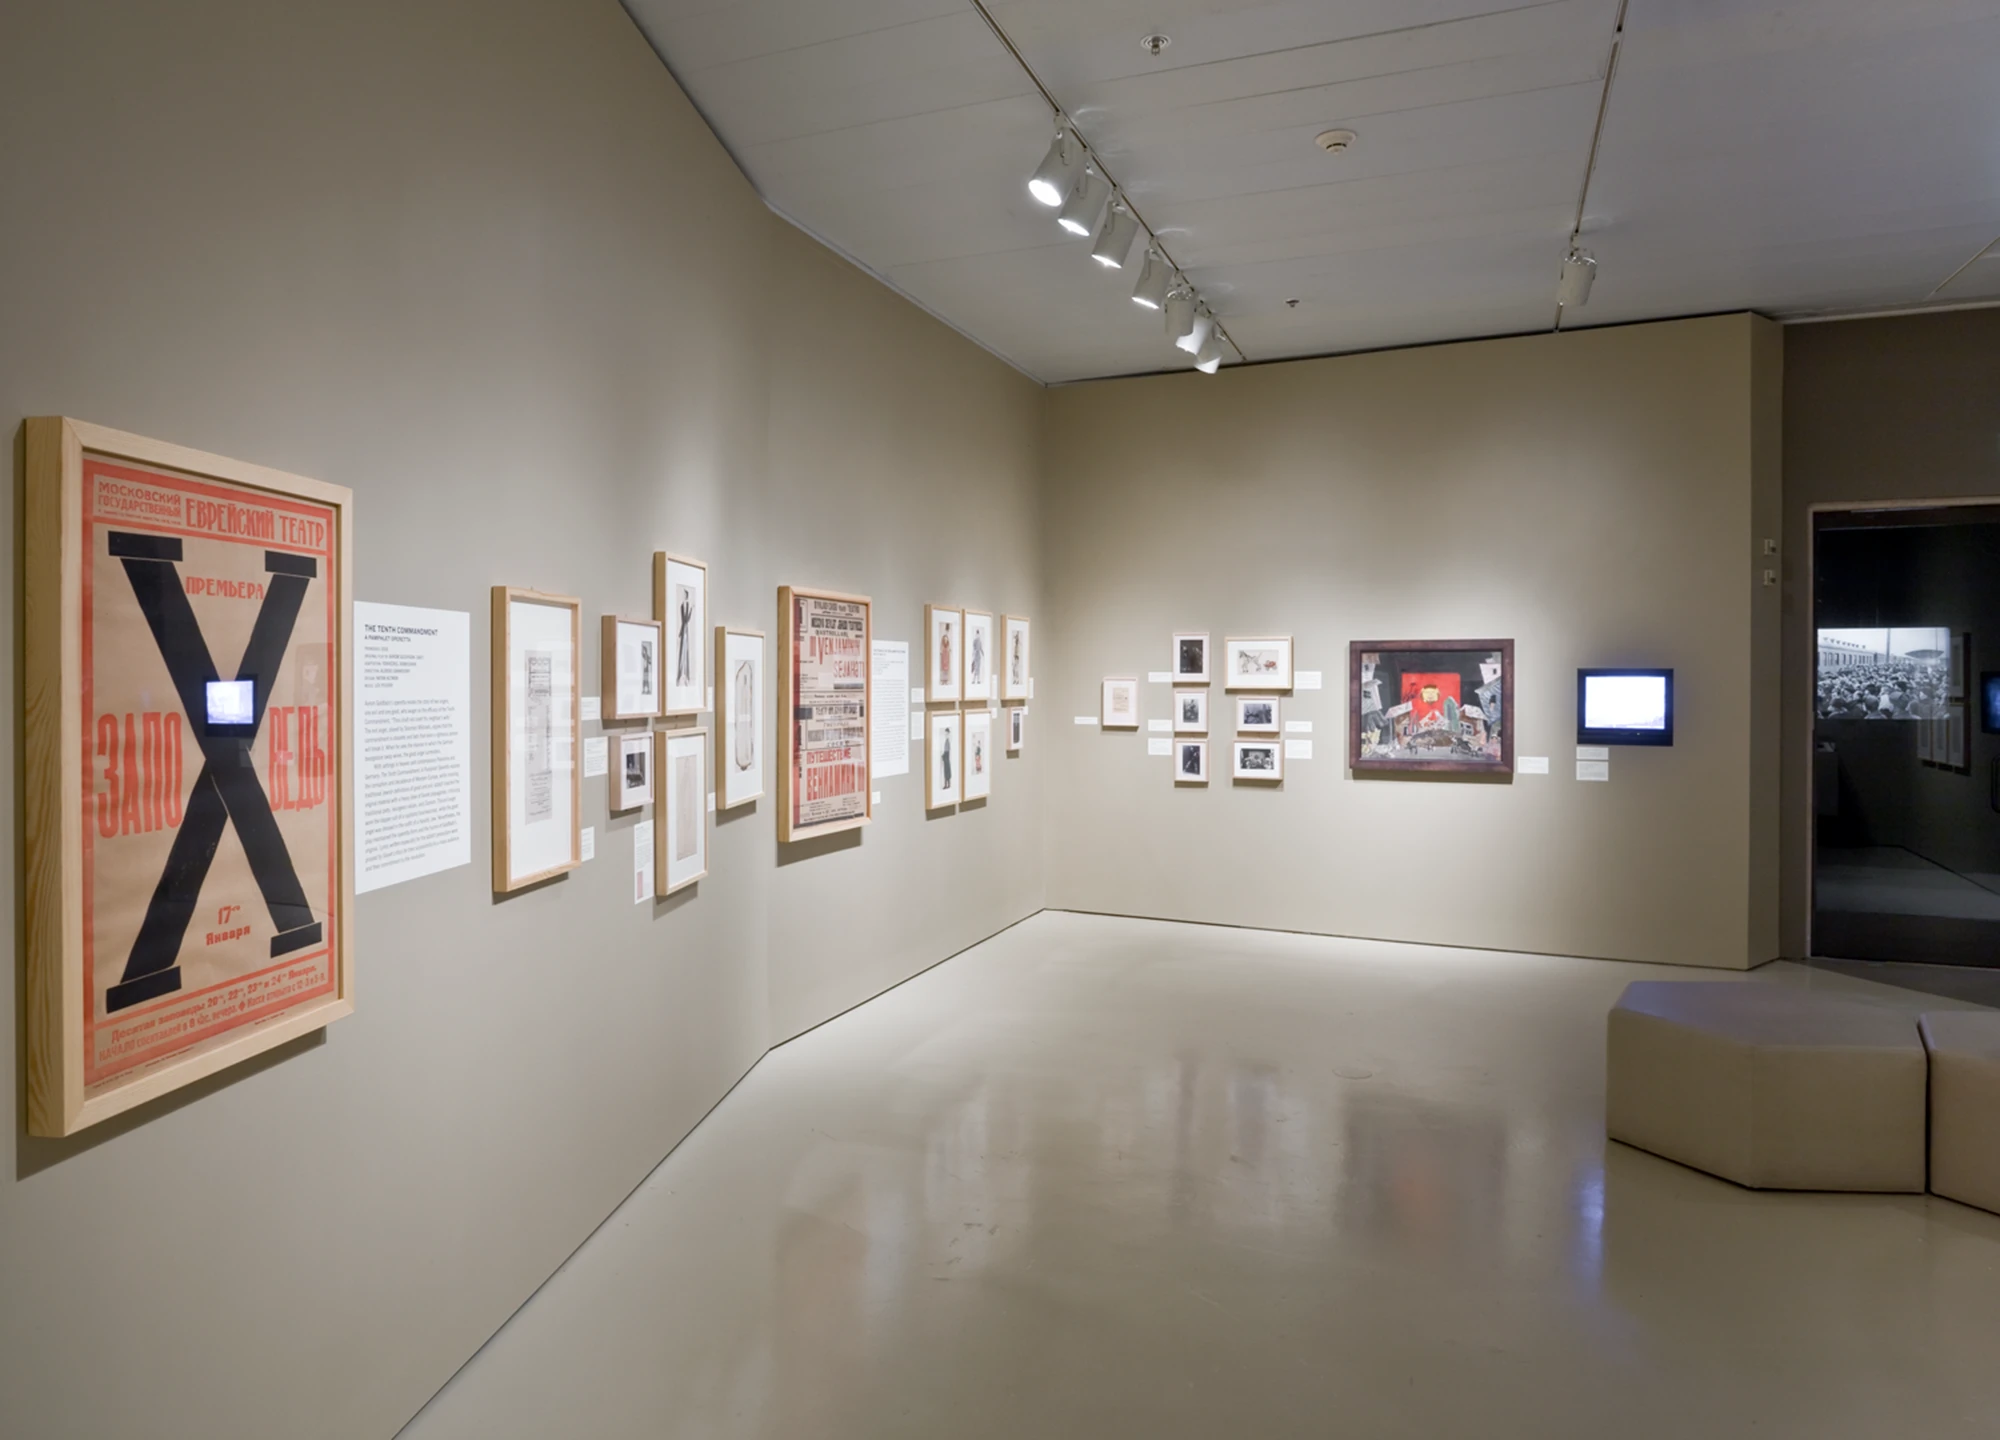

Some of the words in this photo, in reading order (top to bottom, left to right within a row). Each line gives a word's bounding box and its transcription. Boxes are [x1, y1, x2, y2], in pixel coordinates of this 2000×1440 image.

[99, 481, 181, 505] МОСКОВСКИЙ
[98, 495, 181, 518] ГОСУДАРСТВЕННЫЙ
[186, 499, 275, 541] ЕВРЕЙСКИЙ
[279, 515, 324, 547] ТЕАТР
[186, 576, 265, 600] ПРЕМЬЕРА
[365, 624, 376, 632] THE
[377, 625, 396, 633] TENTH
[397, 627, 438, 636] COMMANDMENT
[97, 712, 183, 838] ЗАПО
[269, 706, 326, 812] ВЕДЬ
[206, 926, 251, 946] Января
[112, 1020, 156, 1044] Десятая
[99, 1039, 136, 1061] НАЧАЛО
